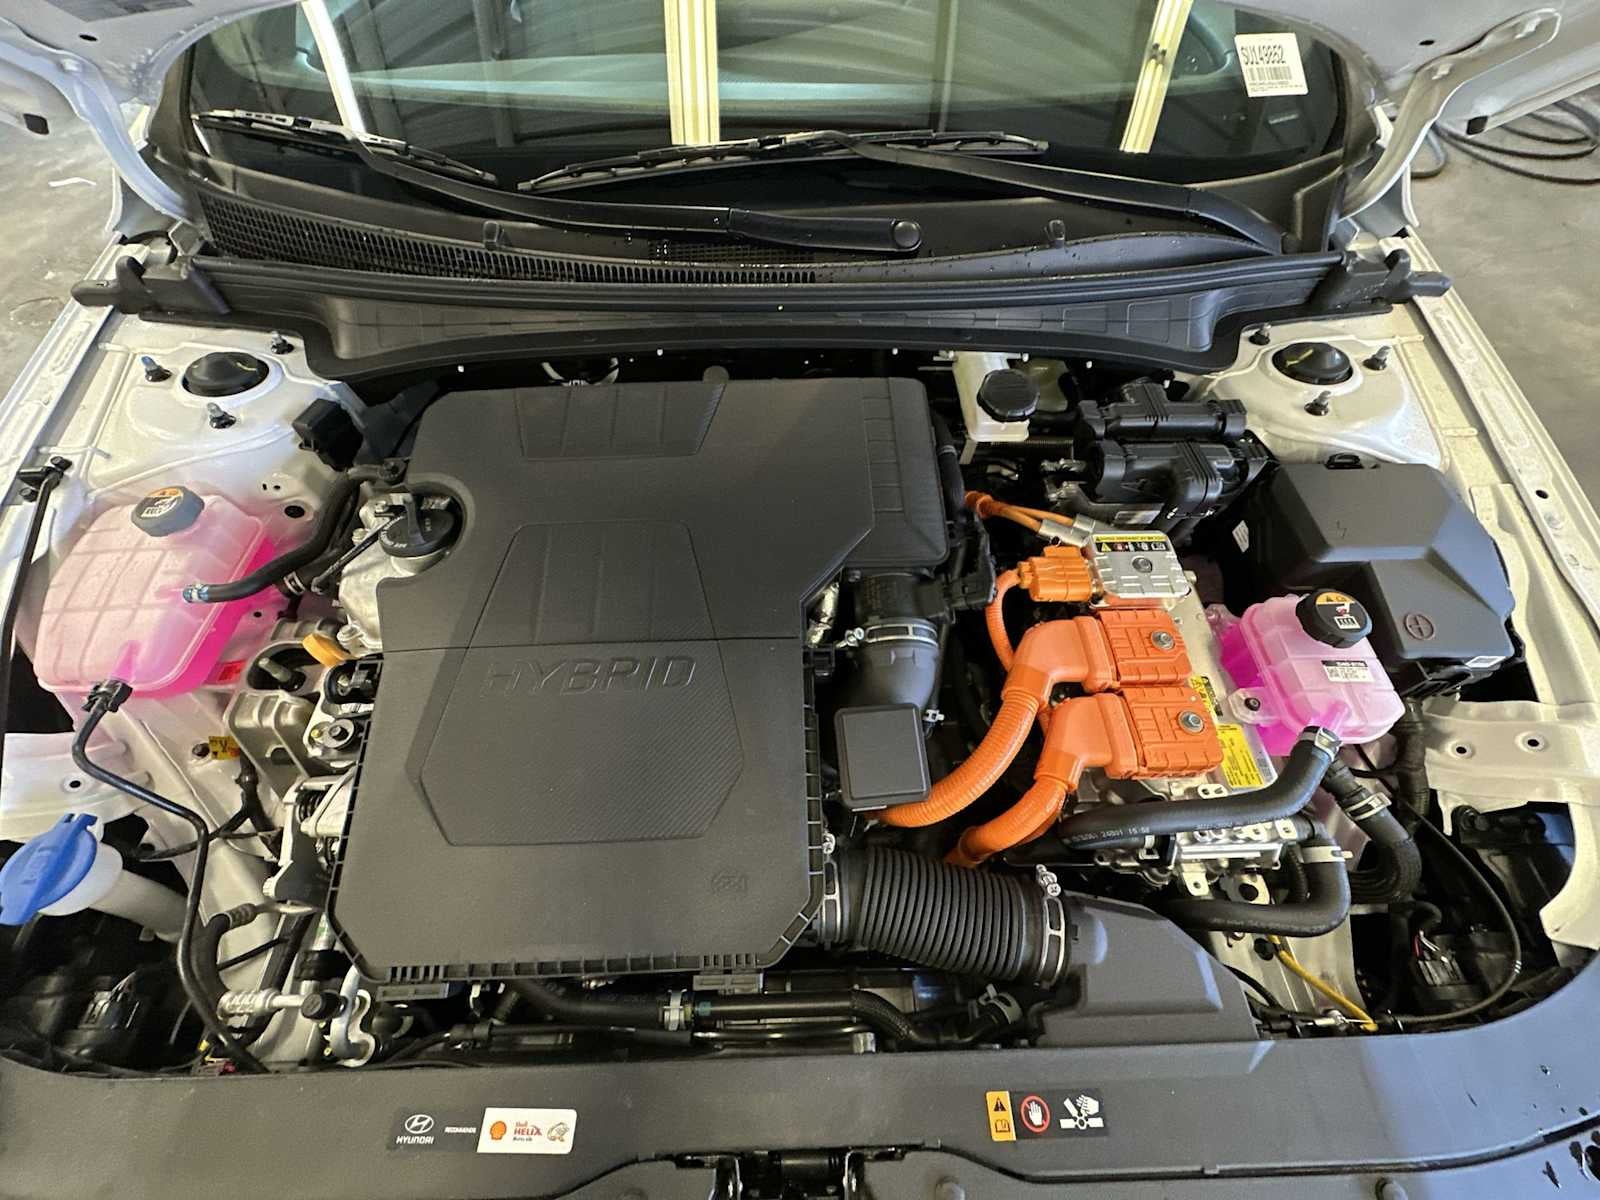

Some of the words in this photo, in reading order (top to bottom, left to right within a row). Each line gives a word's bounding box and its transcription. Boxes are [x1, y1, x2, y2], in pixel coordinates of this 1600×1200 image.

[480, 655, 697, 697] HYBRID
[513, 1125, 543, 1136] HELIX
[396, 1135, 435, 1145] HYUNDAI
